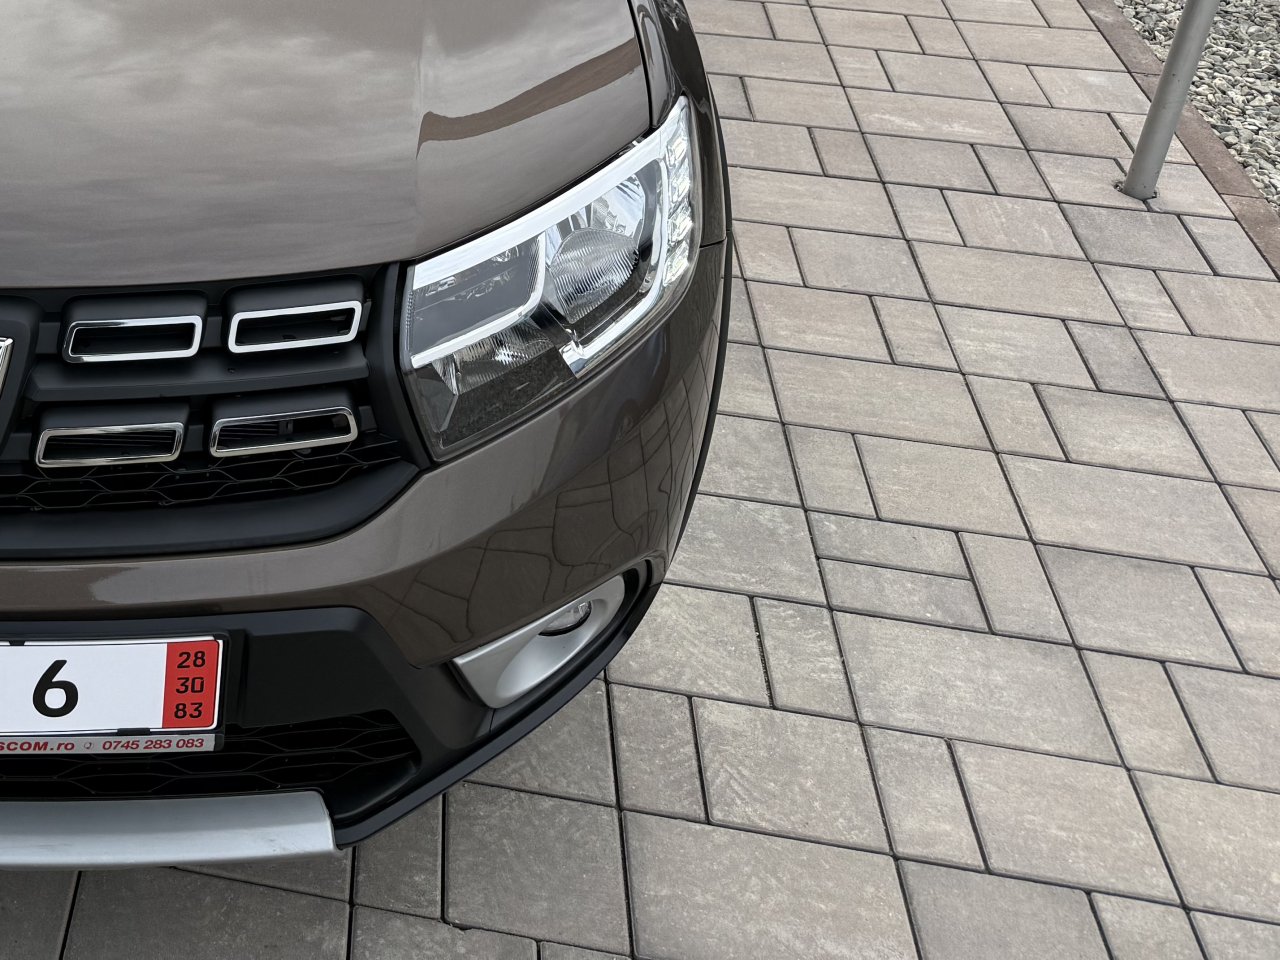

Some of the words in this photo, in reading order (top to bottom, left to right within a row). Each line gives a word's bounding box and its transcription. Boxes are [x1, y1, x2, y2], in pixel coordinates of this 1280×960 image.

[176, 650, 206, 669] 28
[31, 658, 80, 718] 6
[175, 676, 205, 694] 30
[174, 702, 203, 719] 83
[101, 740, 140, 751] 0745
[143, 739, 172, 750] 283
[175, 737, 205, 749] 083
